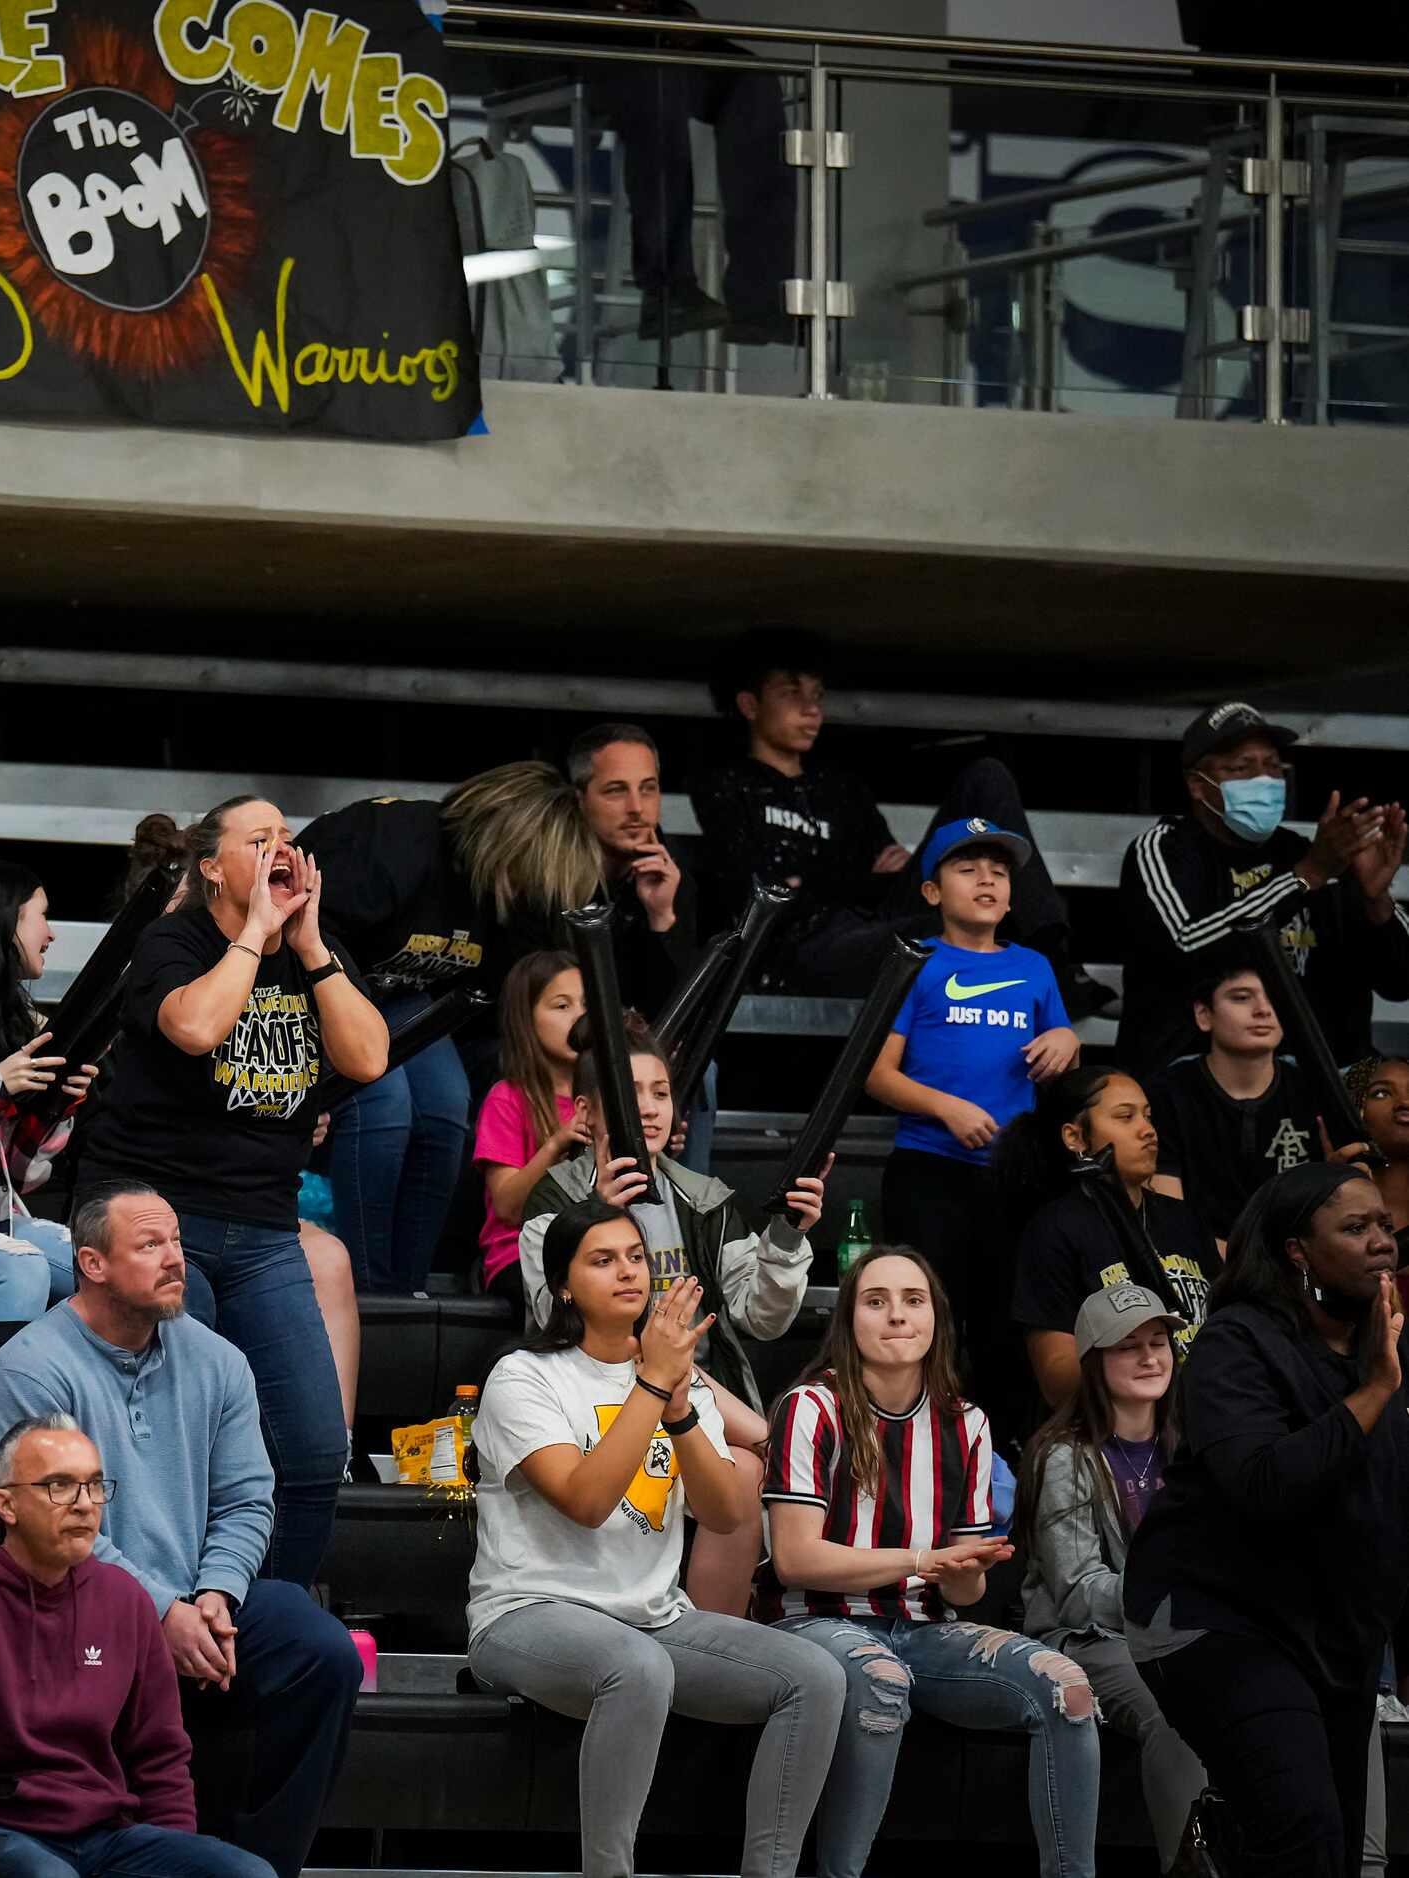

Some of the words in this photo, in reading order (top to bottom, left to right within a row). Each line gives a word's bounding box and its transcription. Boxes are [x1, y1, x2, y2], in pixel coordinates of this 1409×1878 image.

[53, 106, 140, 151] The
[153, 0, 448, 186] COMES
[200, 257, 459, 414] Warriors
[945, 1006, 982, 1024] JUST
[987, 1009, 1009, 1026] DO
